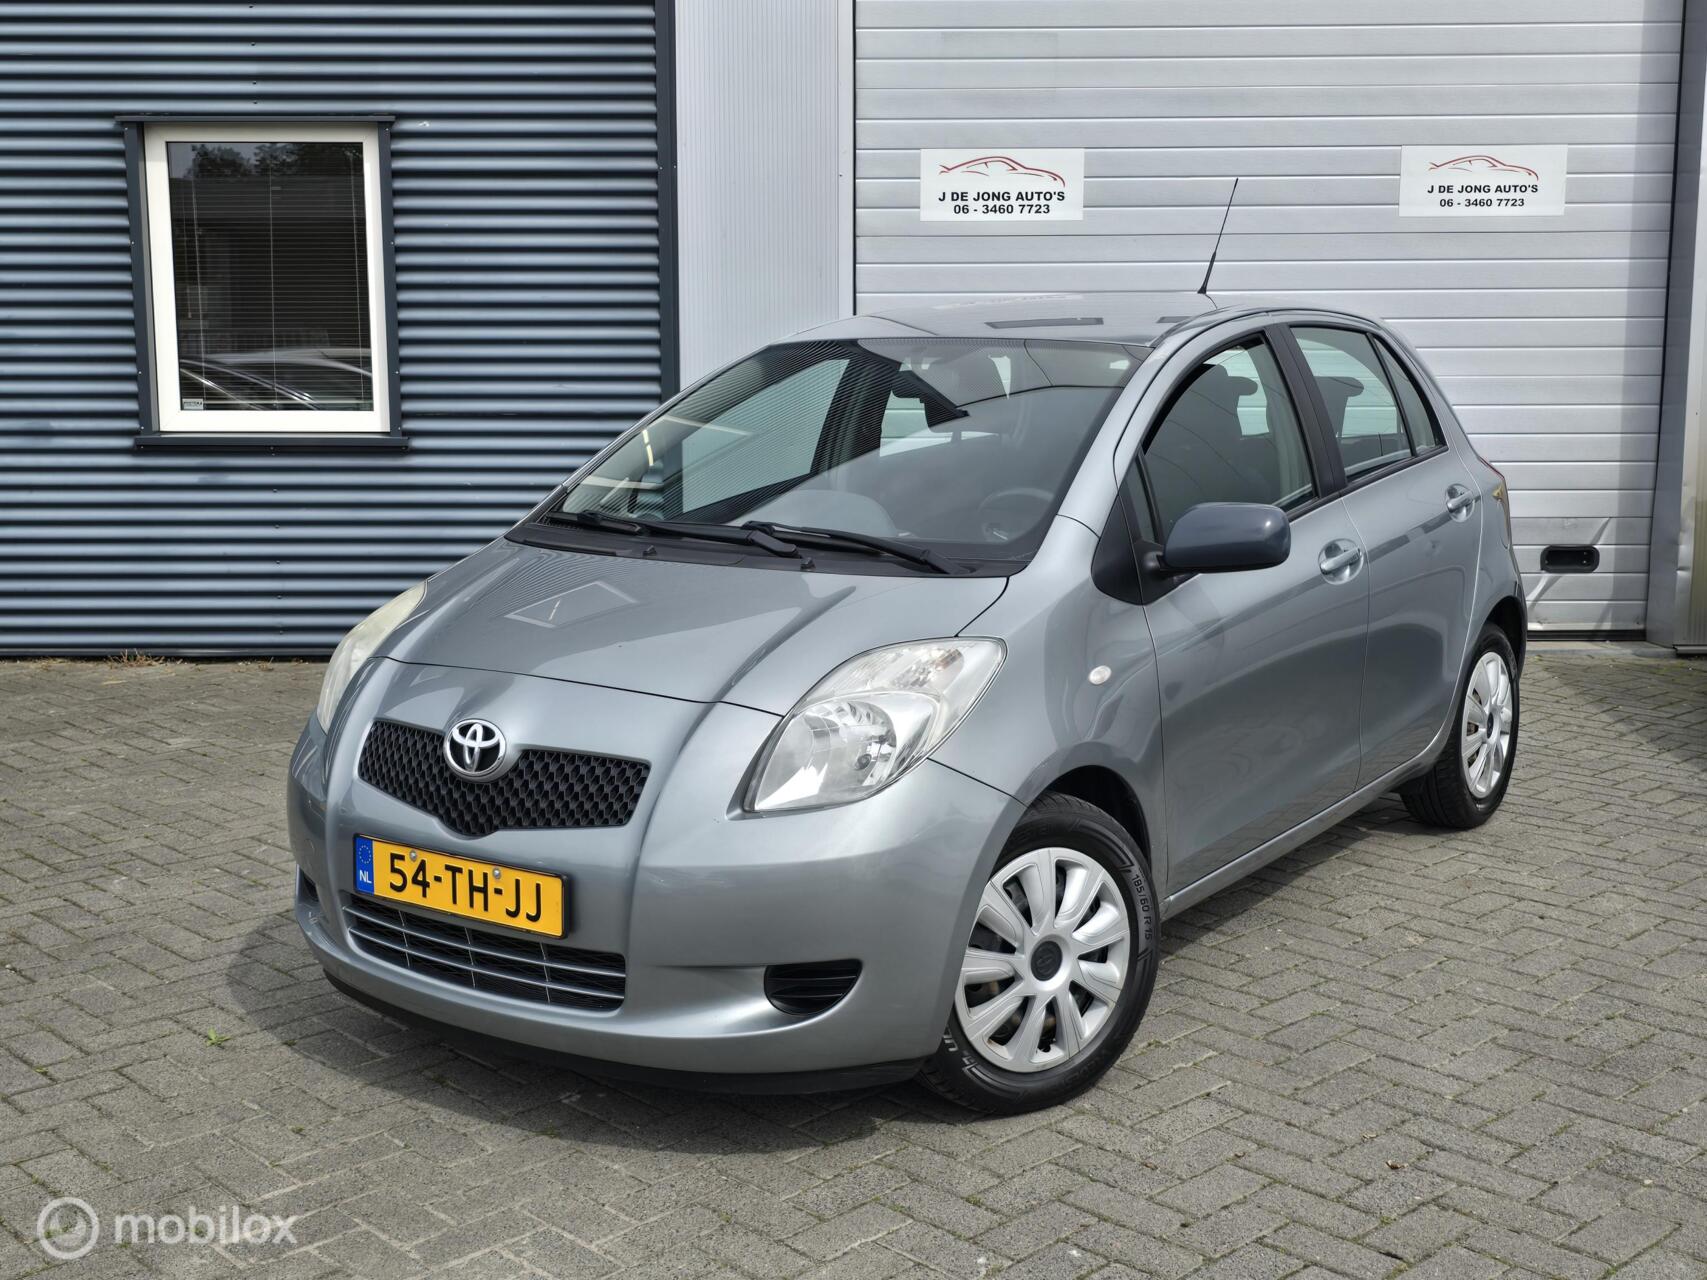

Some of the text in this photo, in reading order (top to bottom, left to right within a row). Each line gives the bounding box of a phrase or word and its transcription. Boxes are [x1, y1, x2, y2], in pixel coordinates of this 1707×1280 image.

[1427, 184, 1539, 194] J DE JONG AUTO'S
[938, 191, 1065, 202] J DE JONG AUTO'S
[1439, 199, 1454, 207] 06
[1464, 199, 1493, 207] 3460
[1497, 198, 1525, 207] 7723
[953, 204, 969, 214] 06
[982, 204, 1014, 214] 3460
[1019, 204, 1050, 214] 7723
[359, 870, 372, 883] NL
[389, 852, 542, 923] 54-TH-JJ
[1132, 874, 1153, 940] 185/60 R 15
